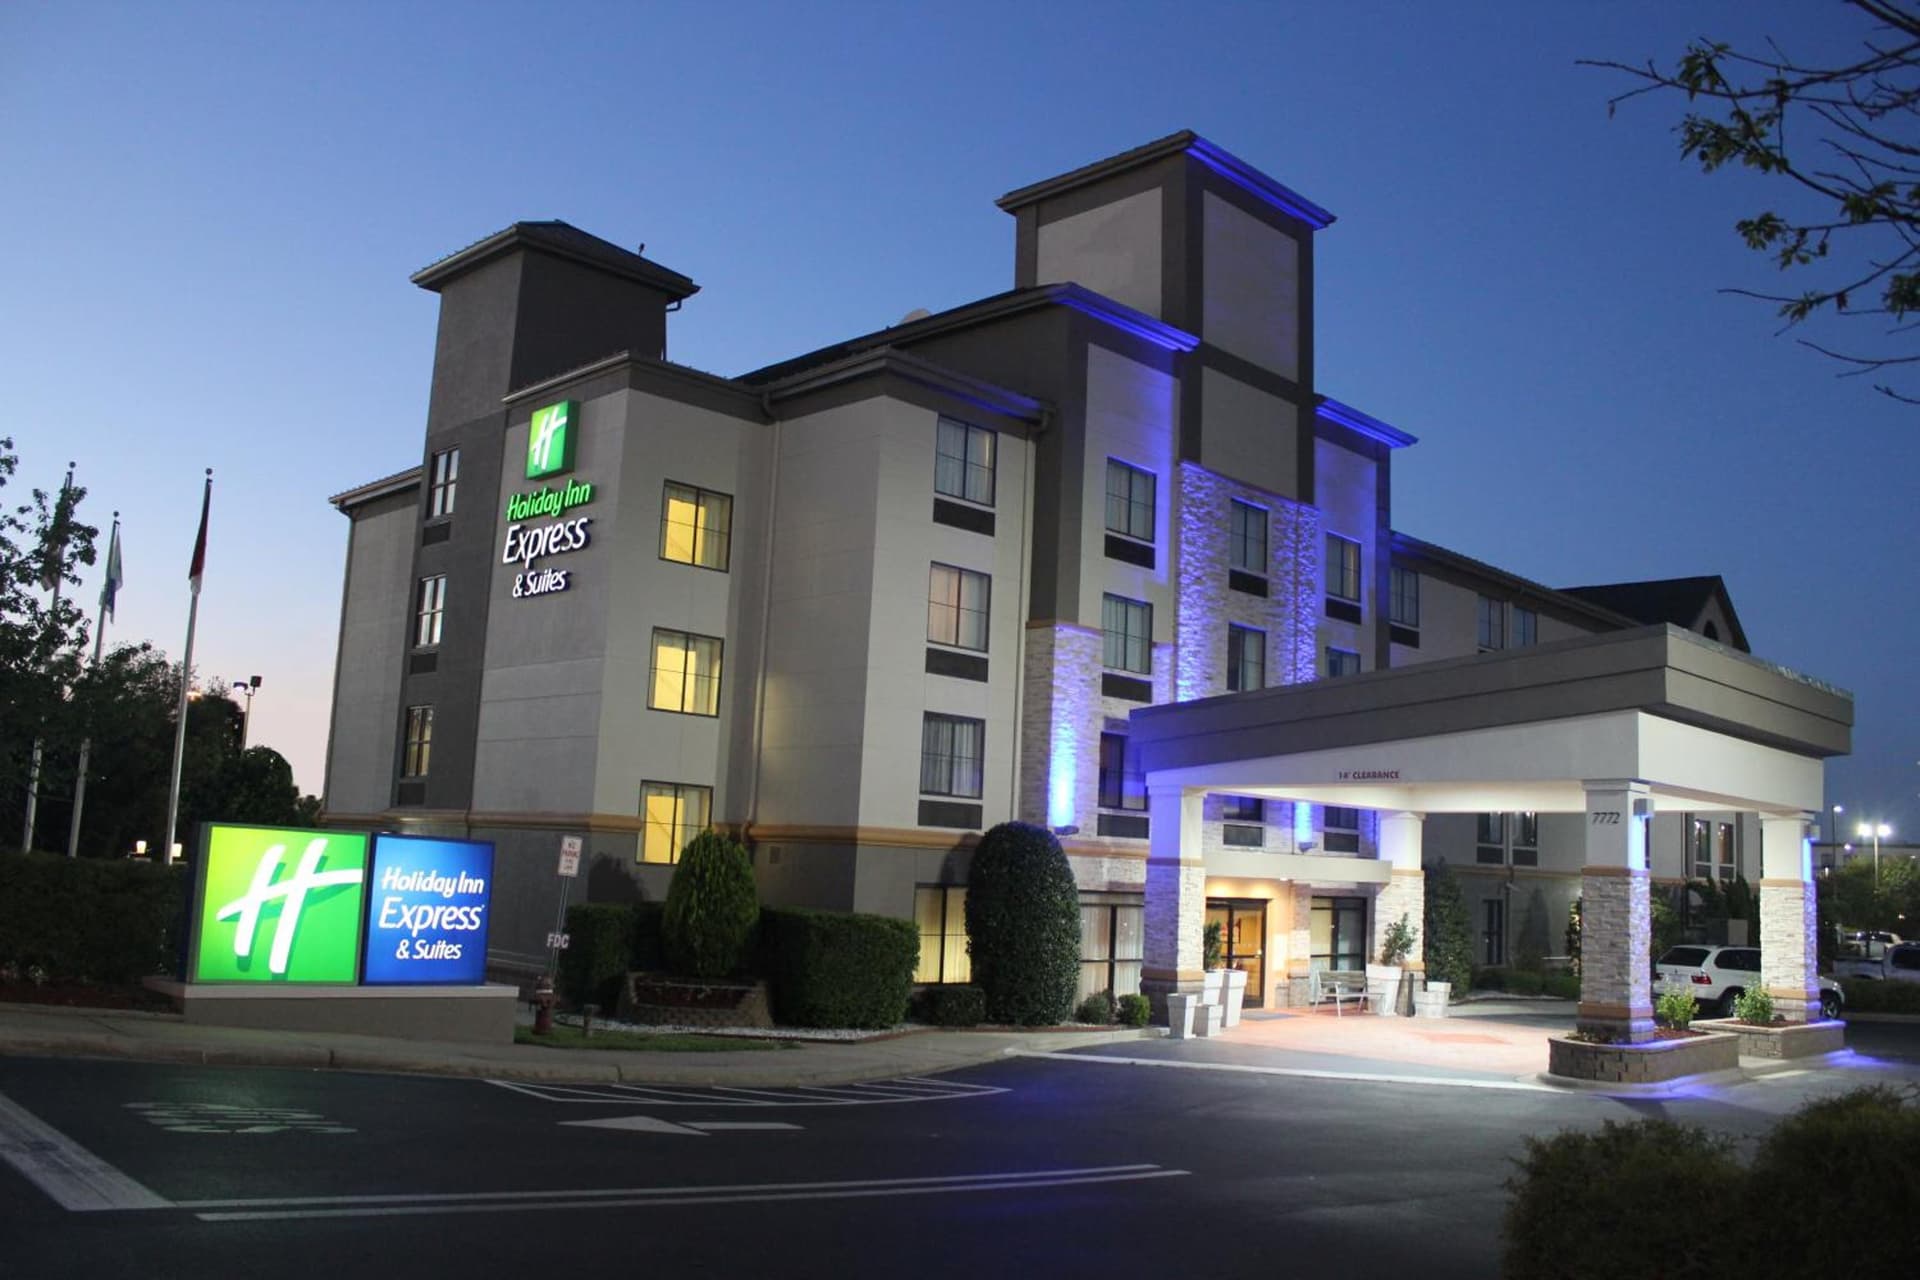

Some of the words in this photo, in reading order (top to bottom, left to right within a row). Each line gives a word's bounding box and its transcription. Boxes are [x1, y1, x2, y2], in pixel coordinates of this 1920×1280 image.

[507, 486, 563, 521] Holiday
[564, 479, 590, 507] Inn
[502, 517, 588, 569] Express
[512, 574, 523, 598] &
[526, 568, 566, 597] Suites
[1352, 771, 1400, 779] CLEARANCE
[1592, 812, 1620, 824] 7772
[382, 866, 456, 898] Holiday
[457, 870, 484, 894] Inn
[378, 896, 482, 938] Express
[396, 939, 409, 959] &
[412, 939, 462, 960] Suites
[546, 933, 569, 948] FDC
